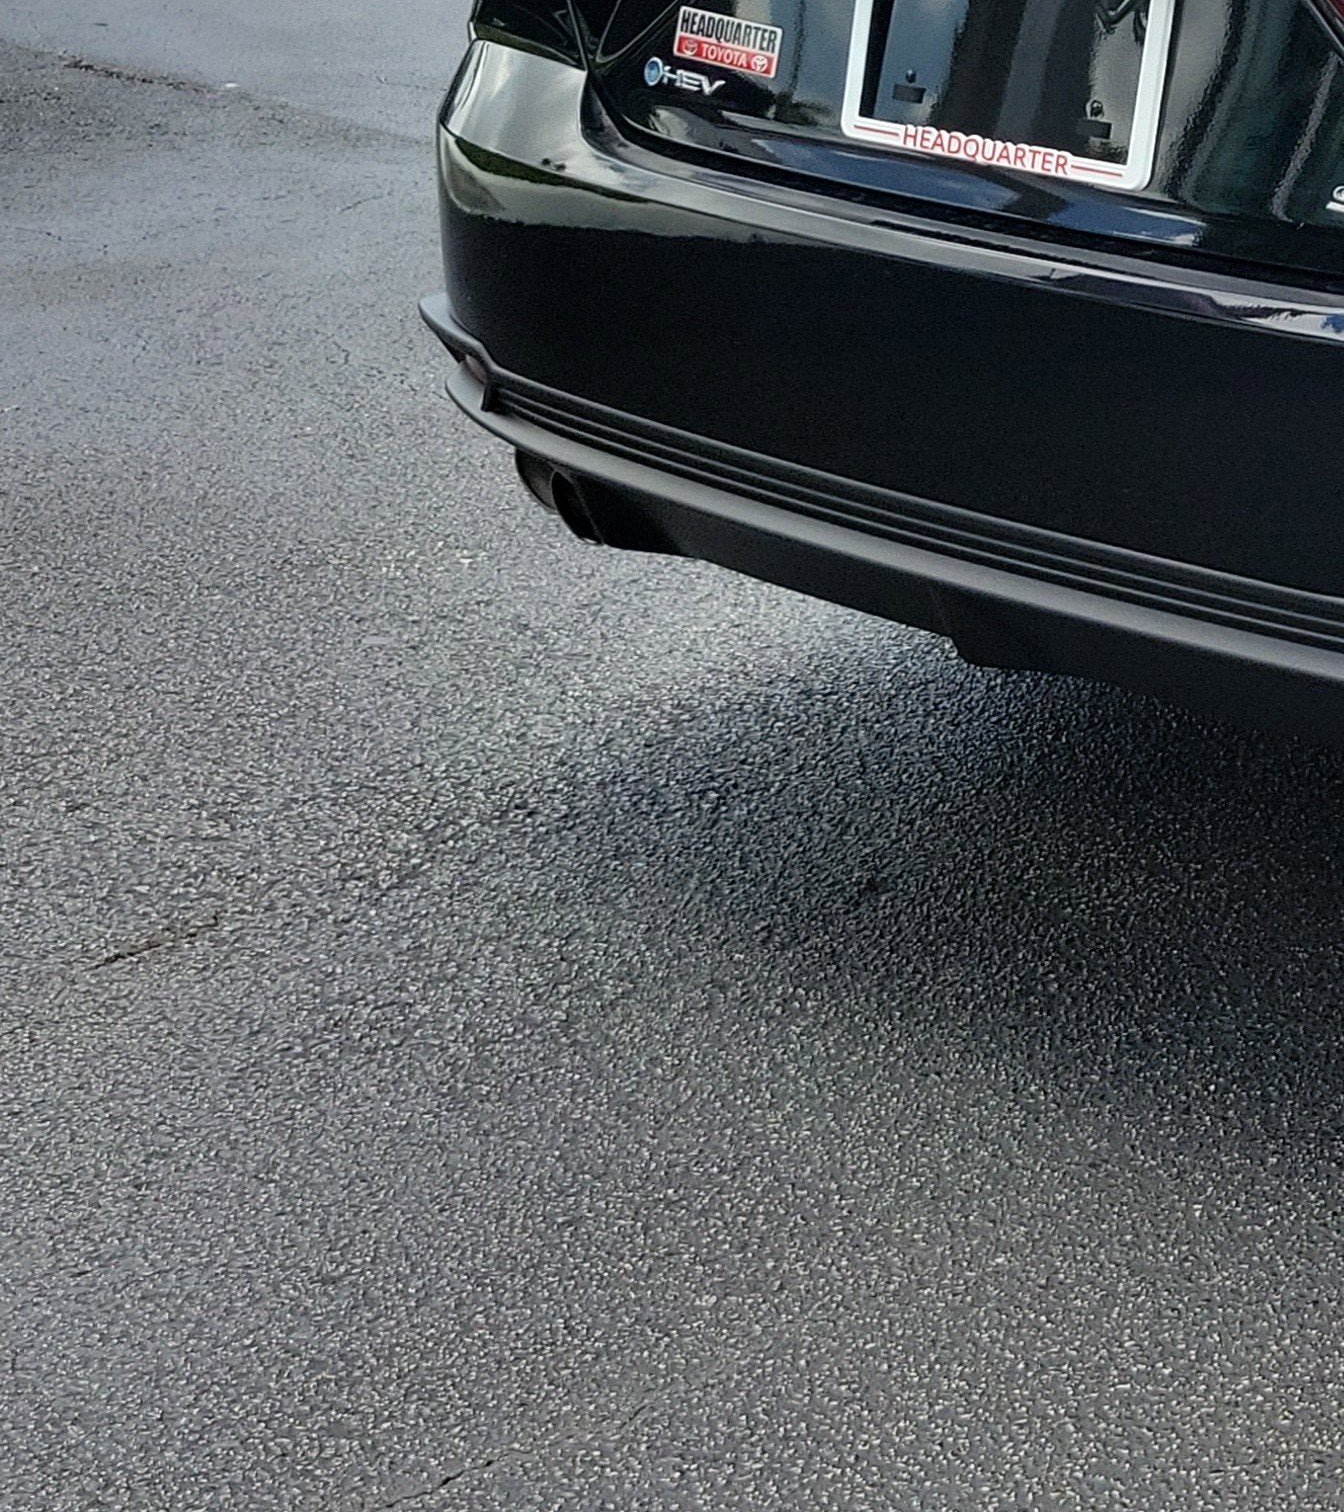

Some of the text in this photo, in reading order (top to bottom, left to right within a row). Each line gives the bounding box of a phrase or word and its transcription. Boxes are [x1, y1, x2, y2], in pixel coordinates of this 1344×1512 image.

[680, 9, 778, 54] HEADQUARTER
[701, 43, 749, 68] TOYOTA
[663, 66, 726, 96] HEV
[902, 124, 1069, 175] HEADQUARTER
